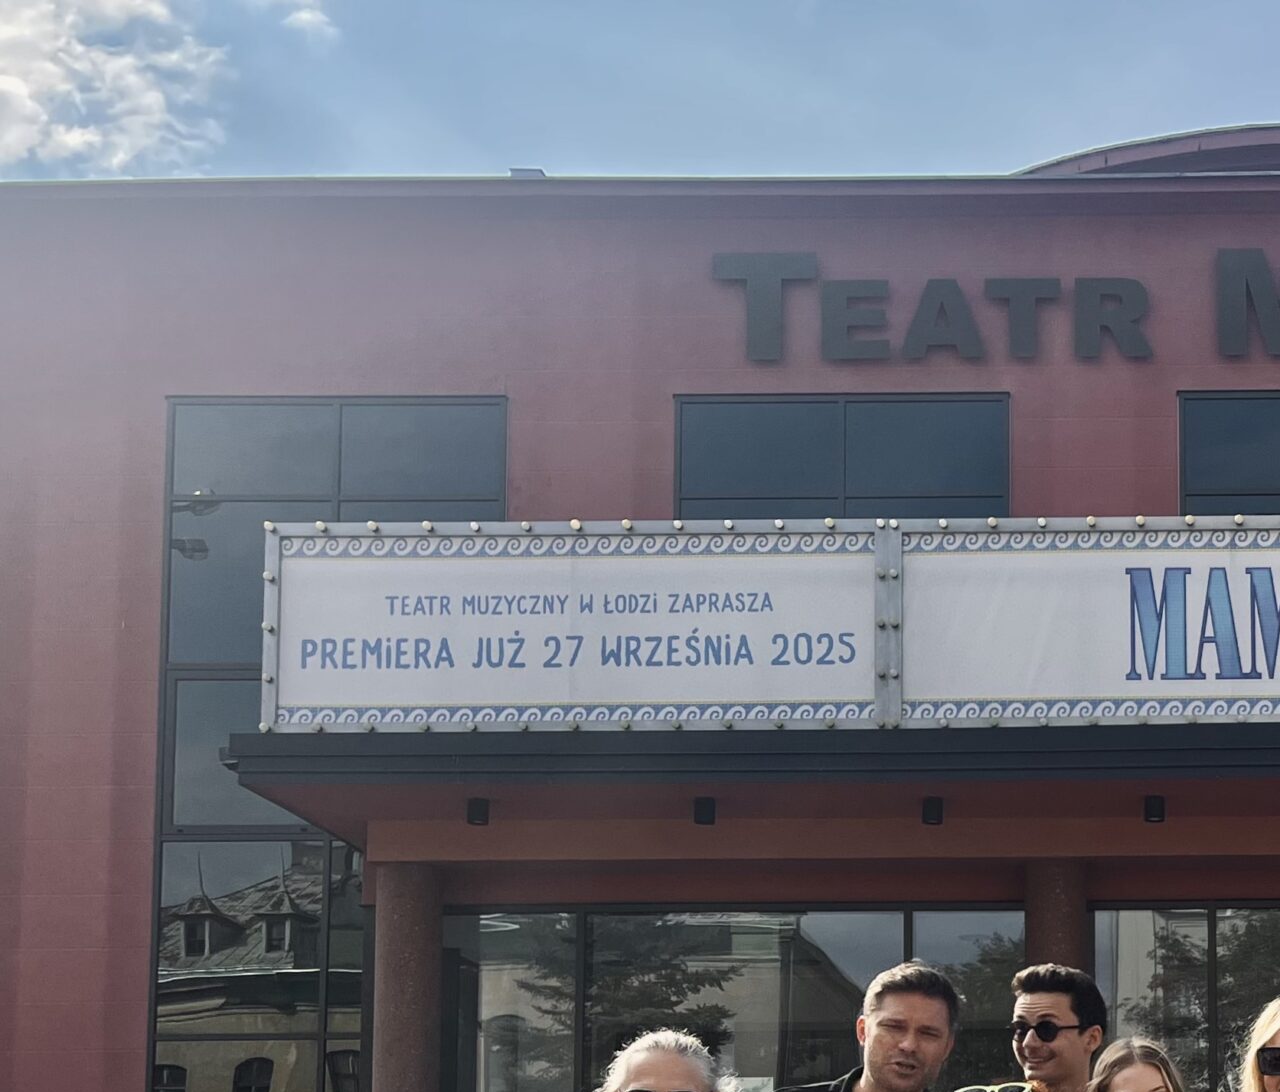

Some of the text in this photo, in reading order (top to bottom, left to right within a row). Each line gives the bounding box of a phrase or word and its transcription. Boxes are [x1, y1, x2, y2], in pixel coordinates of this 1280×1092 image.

[713, 252, 1154, 362] TEATR
[385, 596, 451, 616] TEATR
[463, 595, 568, 615] MUZYCZNY
[580, 594, 593, 613] W
[668, 592, 773, 613] ZAPRASZA
[472, 630, 526, 668] JUŻ
[543, 636, 583, 668] 27
[771, 633, 855, 665] 2025
